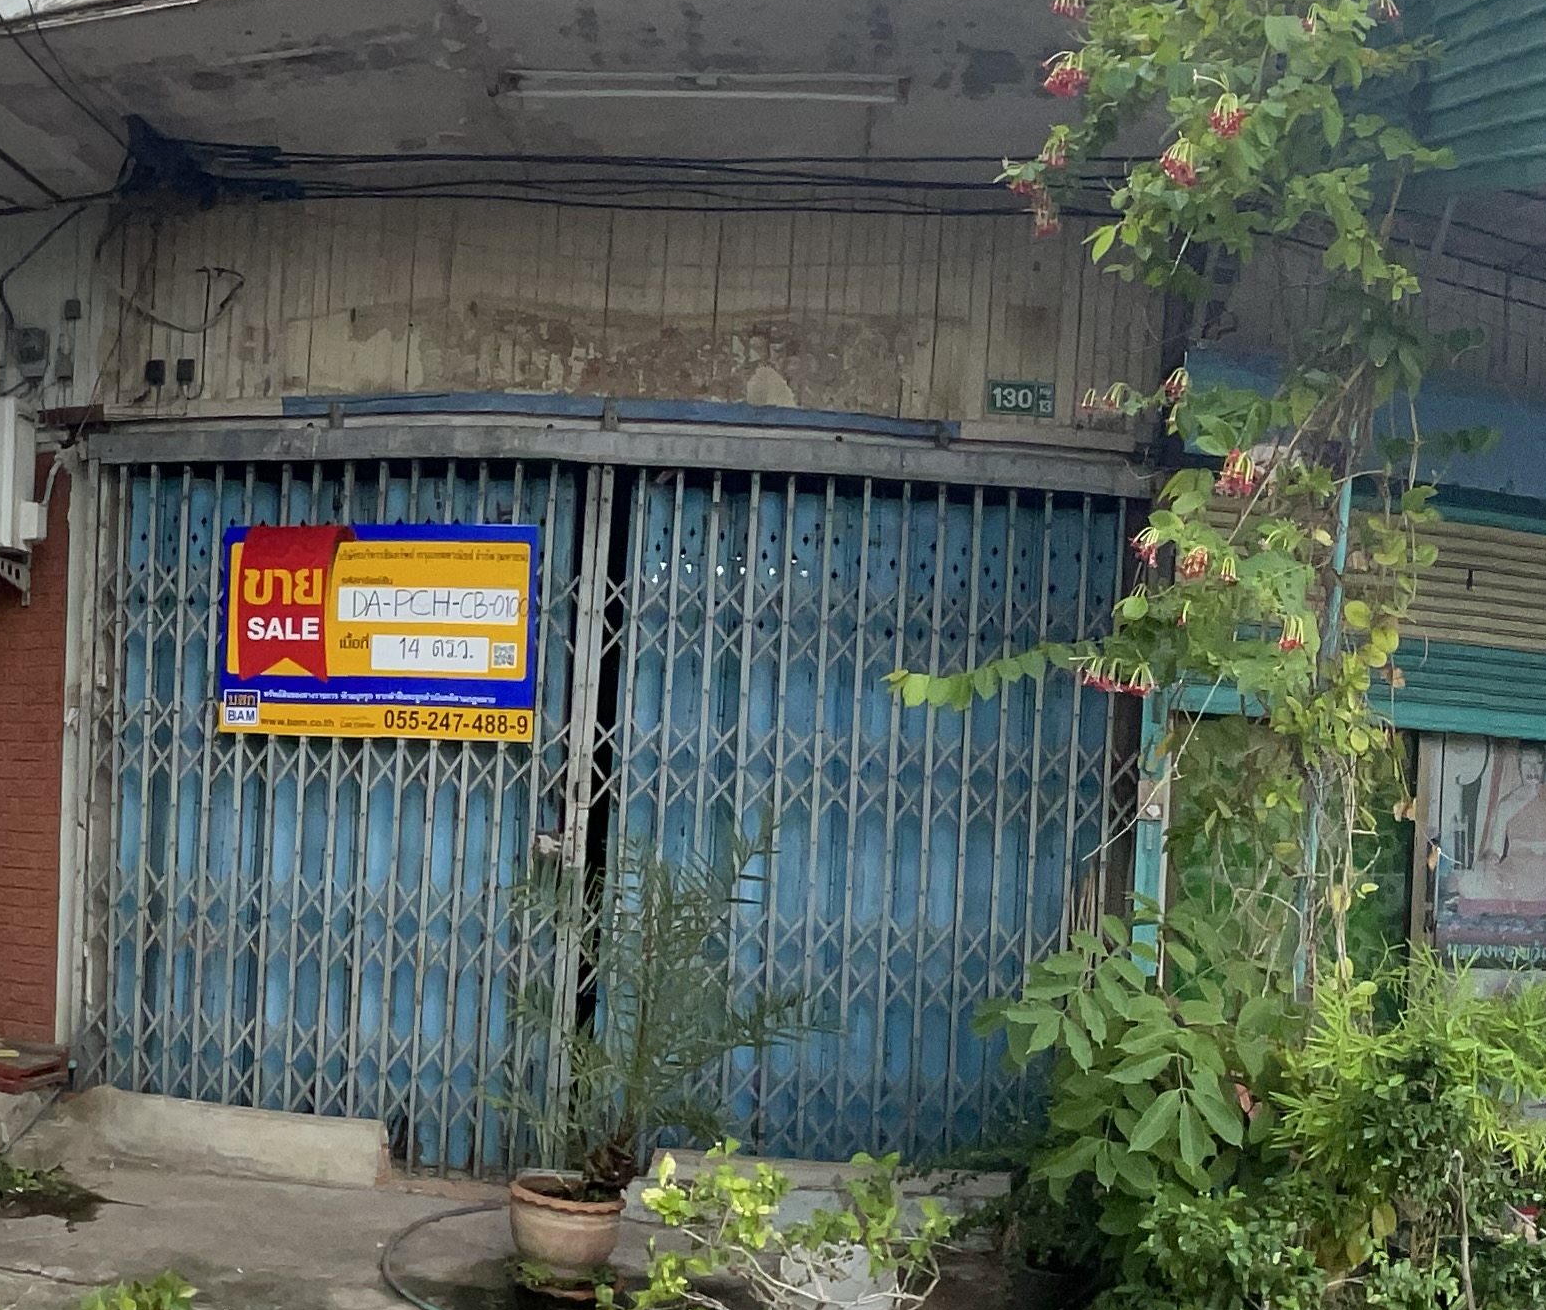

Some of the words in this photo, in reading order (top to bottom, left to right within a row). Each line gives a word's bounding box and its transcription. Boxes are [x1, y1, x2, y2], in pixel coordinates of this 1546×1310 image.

[992, 387, 1032, 409] 130
[244, 568, 323, 606] ขาย
[246, 616, 320, 641] SALE
[399, 637, 420, 659] 14
[228, 710, 255, 721] BAM
[384, 709, 528, 735] 055-247-488-9
